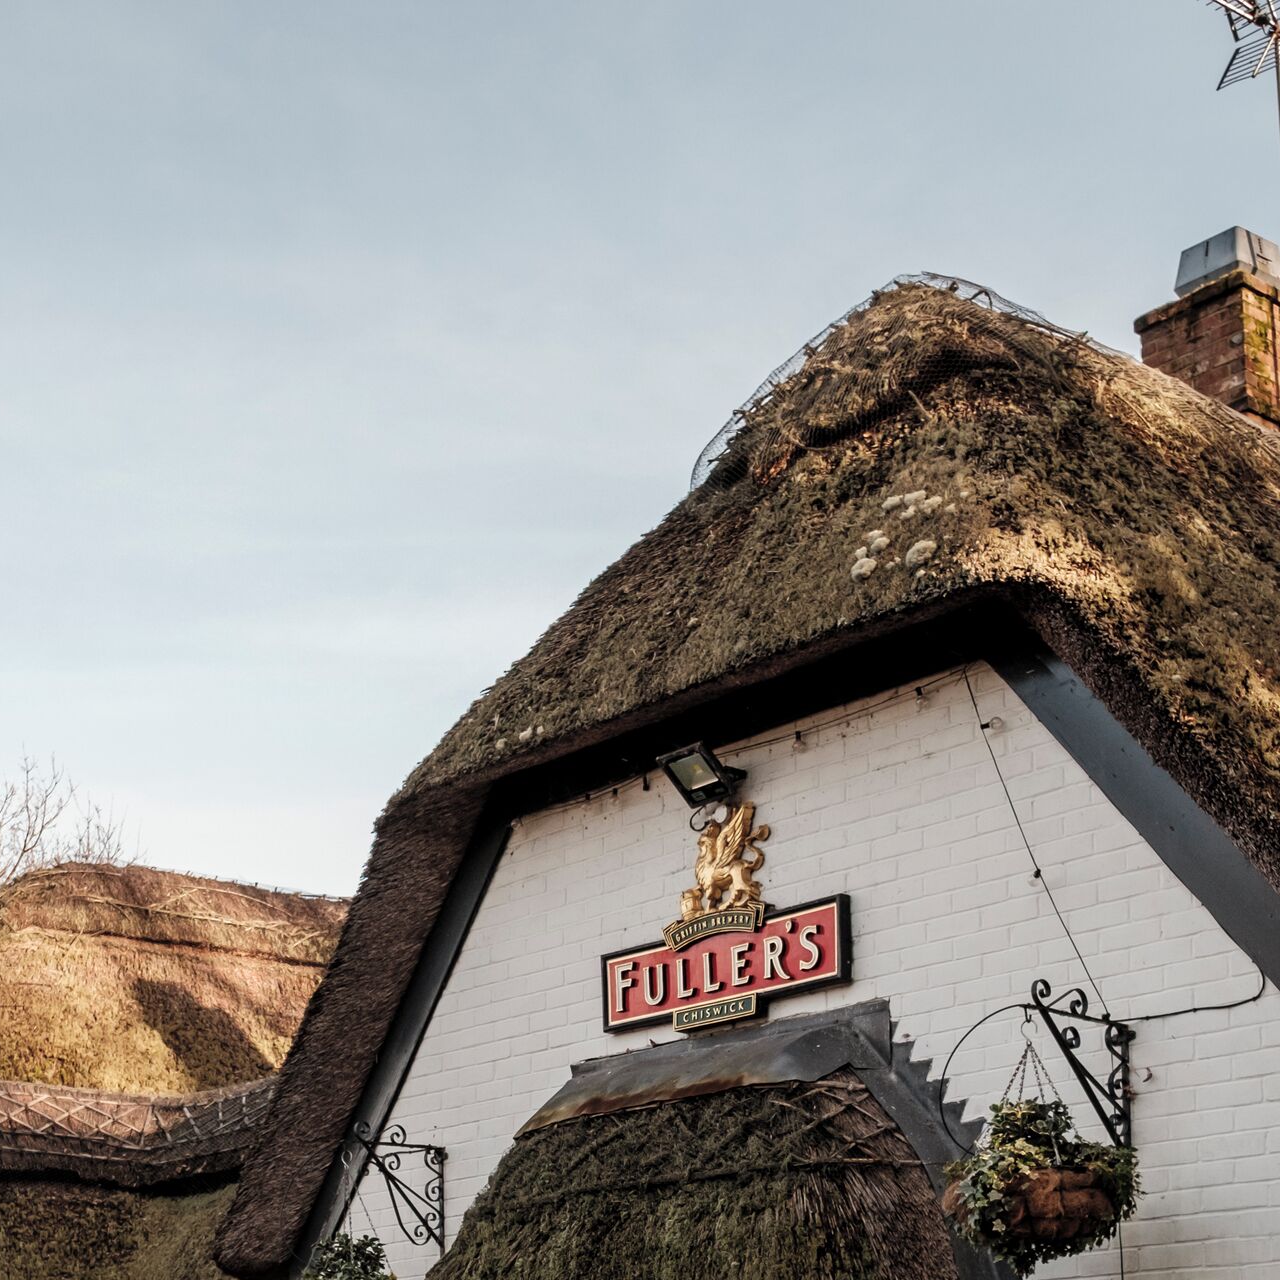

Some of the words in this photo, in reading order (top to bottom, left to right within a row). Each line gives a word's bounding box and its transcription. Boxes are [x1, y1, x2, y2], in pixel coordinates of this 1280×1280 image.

[675, 920, 708, 942] GRIFFIN
[711, 915, 750, 925] BREWERY
[614, 920, 821, 1013] FULLER'S
[683, 1001, 744, 1023] CHISWICK
